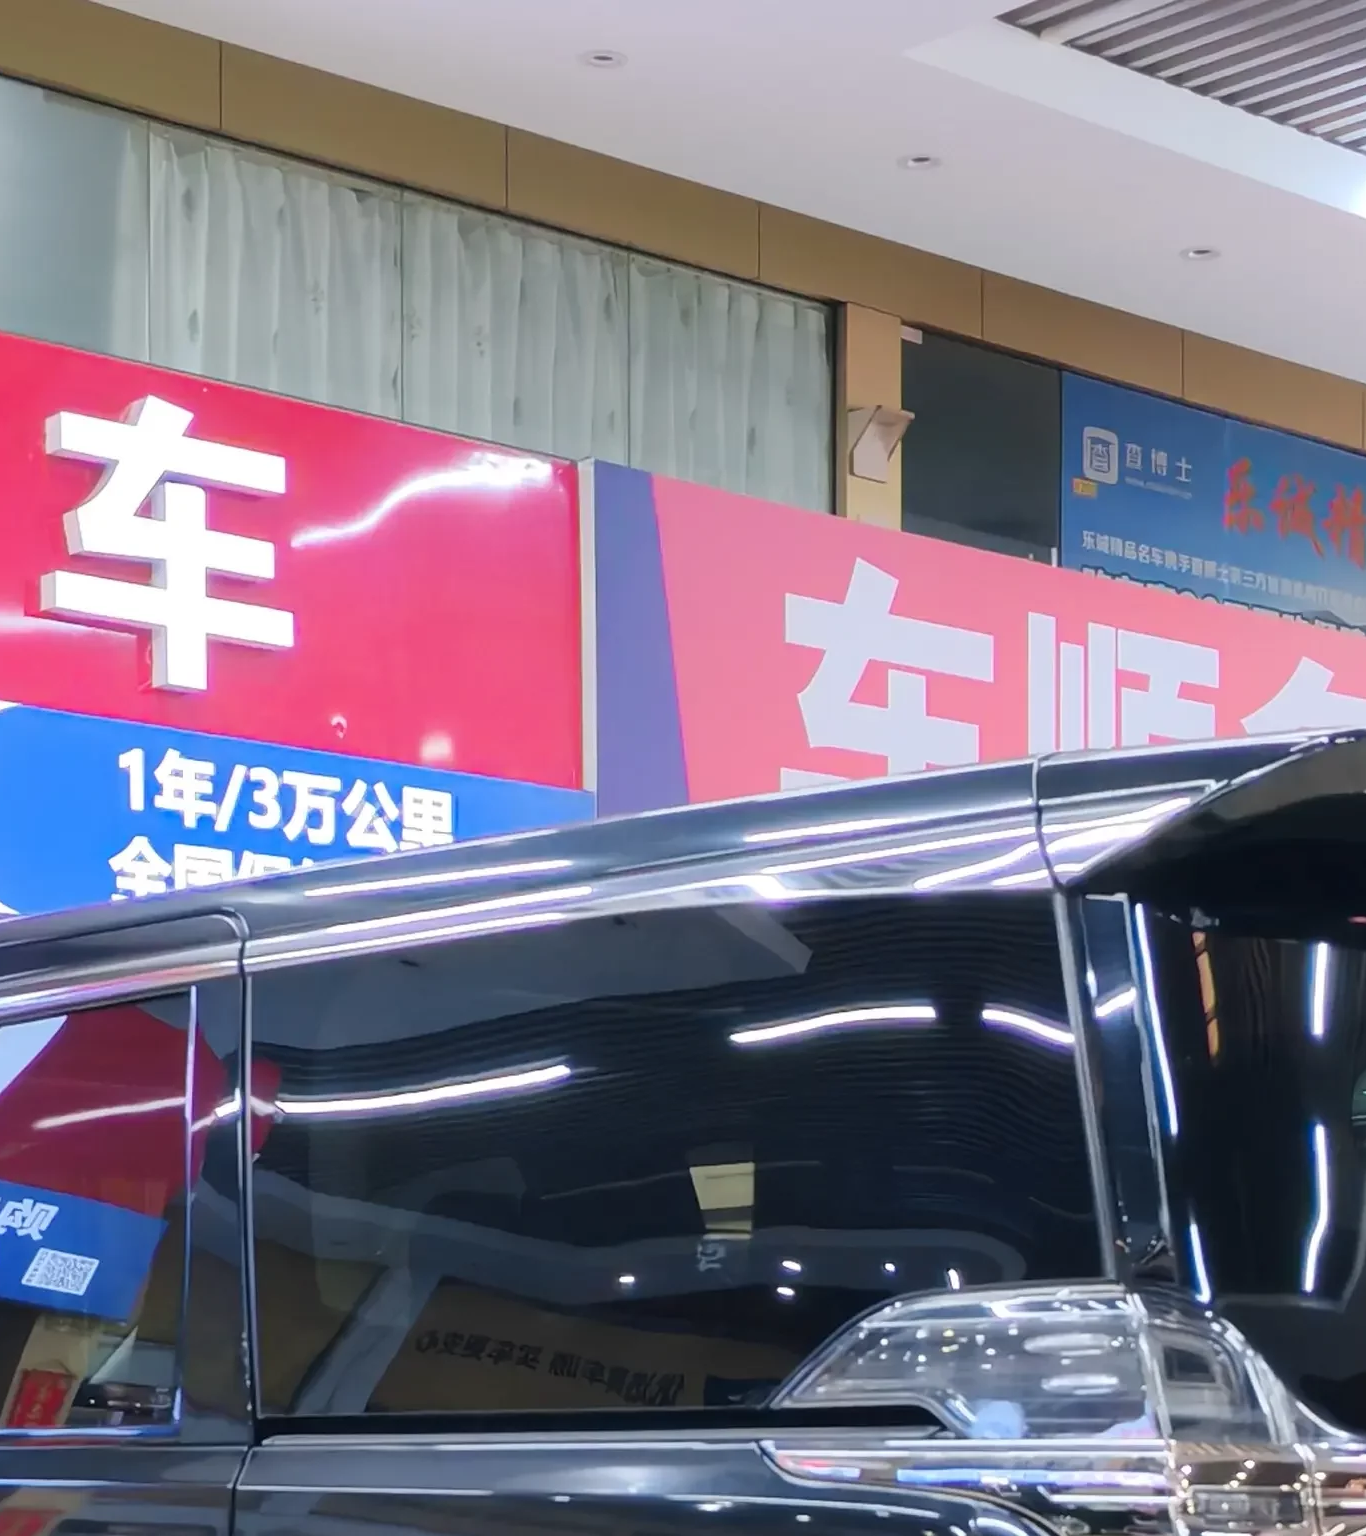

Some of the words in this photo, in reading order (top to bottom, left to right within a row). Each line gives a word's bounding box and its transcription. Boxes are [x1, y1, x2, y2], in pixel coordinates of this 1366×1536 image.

[1124, 442, 1193, 483] 查博士
[117, 747, 455, 853] 1年/3万公里
